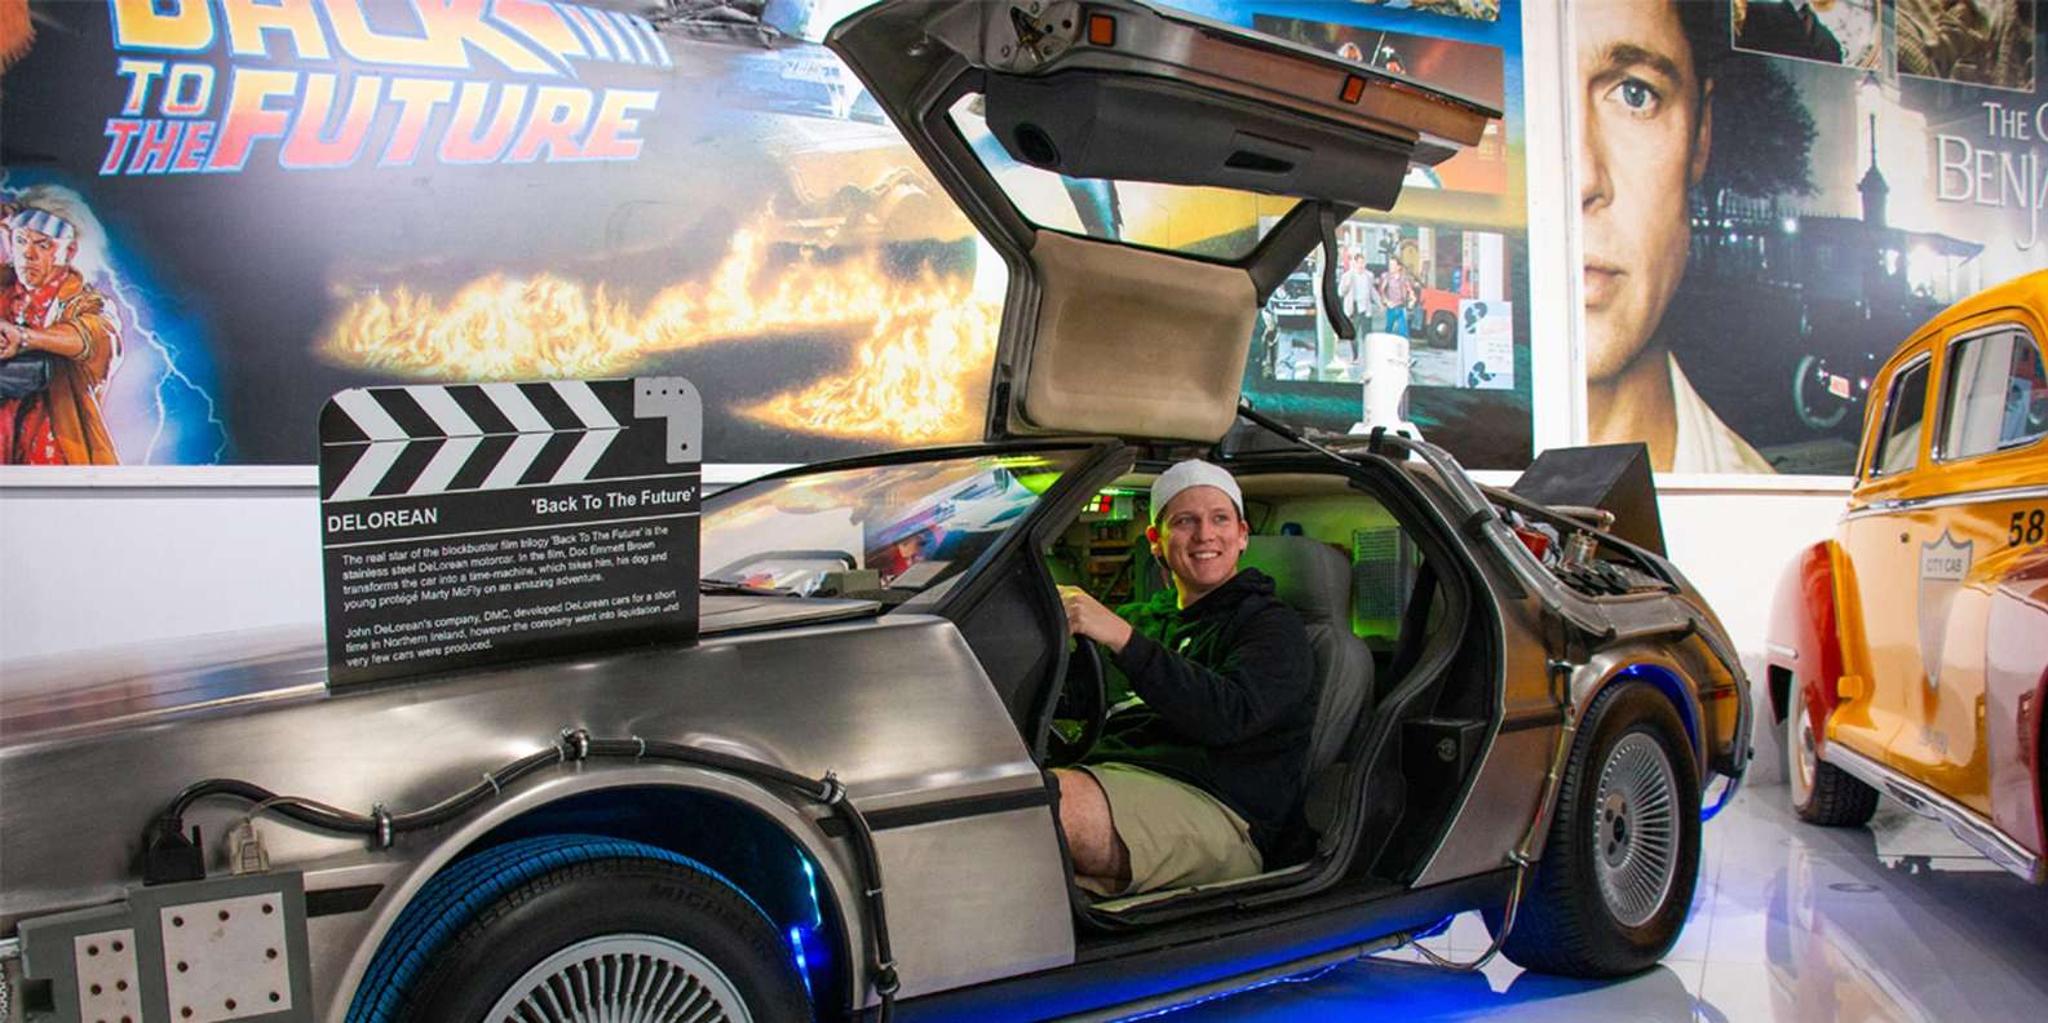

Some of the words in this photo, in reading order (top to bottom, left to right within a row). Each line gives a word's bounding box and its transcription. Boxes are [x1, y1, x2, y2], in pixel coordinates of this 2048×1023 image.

[118, 57, 216, 118] TO
[98, 118, 216, 176] THE
[203, 64, 661, 173] FUTURE
[1982, 101, 2031, 141] THE
[327, 507, 438, 533] DELOREAN
[531, 497, 579, 514] 'Back
[582, 494, 601, 510] To
[606, 492, 637, 508] The
[641, 486, 696, 506] Future'
[342, 553, 363, 564] The
[365, 550, 386, 562] real
[388, 549, 408, 560] star
[411, 547, 422, 558] of
[423, 546, 440, 557] the
[442, 541, 498, 555] blockbuster
[500, 538, 518, 550] film
[520, 536, 549, 549] trilogy
[580, 532, 591, 542] To
[592, 530, 610, 541] The
[645, 526, 652, 536] is
[654, 525, 668, 535] the
[2008, 508, 2046, 548] 58
[342, 567, 388, 580] stainless
[391, 563, 416, 575] steel
[418, 560, 468, 572] DeLorean
[530, 550, 545, 561] the
[569, 546, 588, 556] Doc
[590, 541, 625, 554] Emmett
[627, 540, 656, 550] Brown
[343, 581, 399, 594] transforms
[402, 577, 418, 588] the
[420, 577, 437, 586] car
[439, 573, 457, 584] into
[460, 574, 467, 582] a
[540, 561, 566, 573] which
[568, 559, 592, 570] takes
[616, 555, 629, 565] his
[632, 553, 648, 565] dog
[651, 550, 668, 562] and
[1944, 558, 1963, 572] CAB
[344, 599, 377, 612] young
[421, 588, 450, 601] Marty
[452, 585, 482, 597] McFly
[484, 585, 496, 593] on
[499, 583, 512, 592] an
[514, 577, 554, 590] amazing
[344, 626, 371, 638] John
[514, 602, 563, 617] developed
[564, 599, 609, 611] DeLorean
[611, 597, 630, 606] cars
[632, 593, 644, 603] for
[645, 594, 652, 602] a
[654, 588, 676, 601] short
[346, 641, 368, 652] time
[371, 639, 381, 649] in
[384, 634, 428, 647] Northern
[470, 624, 511, 636] however
[513, 620, 529, 631] the
[530, 617, 572, 629] company
[575, 611, 596, 623] went
[599, 609, 615, 620] into
[617, 604, 661, 620] liquidation
[663, 600, 680, 612] and
[346, 655, 369, 666] very
[372, 652, 391, 662] few
[392, 650, 415, 660] cars
[417, 647, 442, 657] were
[444, 639, 493, 654] produced.
